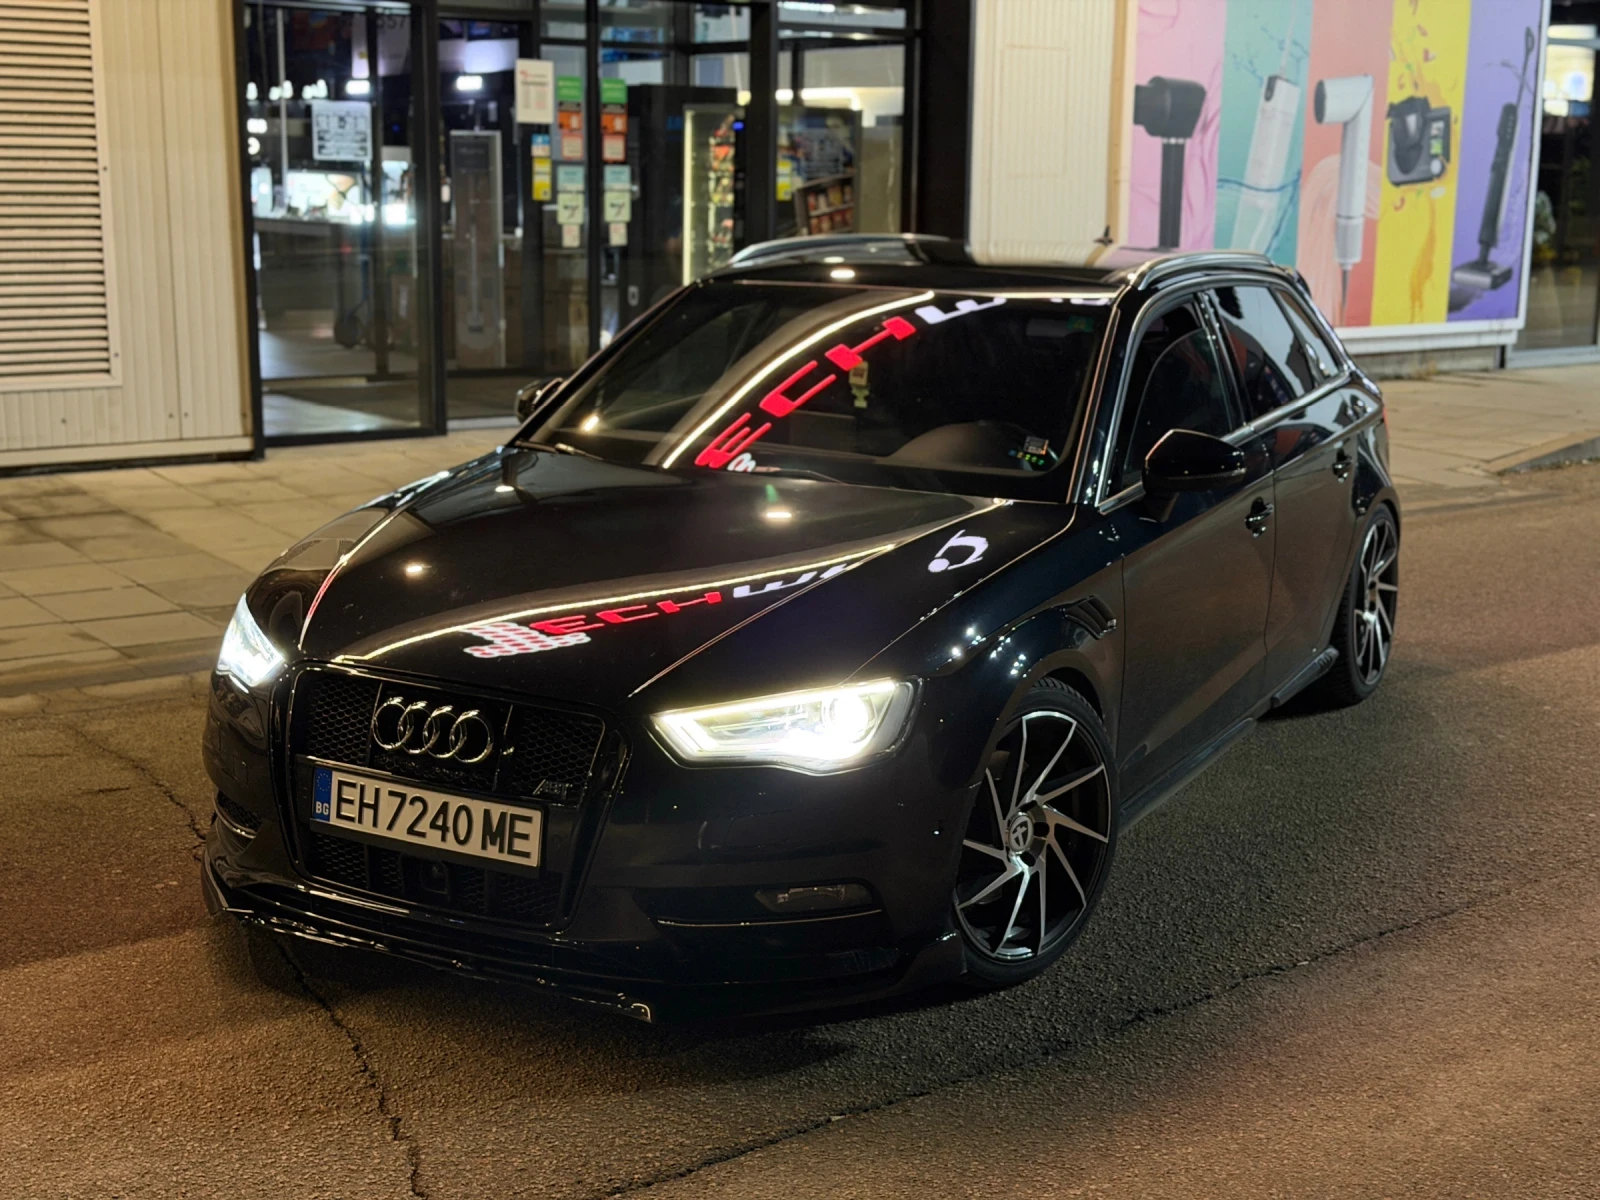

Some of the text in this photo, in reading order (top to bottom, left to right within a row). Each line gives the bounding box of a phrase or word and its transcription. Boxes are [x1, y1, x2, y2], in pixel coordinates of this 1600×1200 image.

[315, 801, 330, 816] BG
[336, 778, 533, 859] EH 7240 ME
